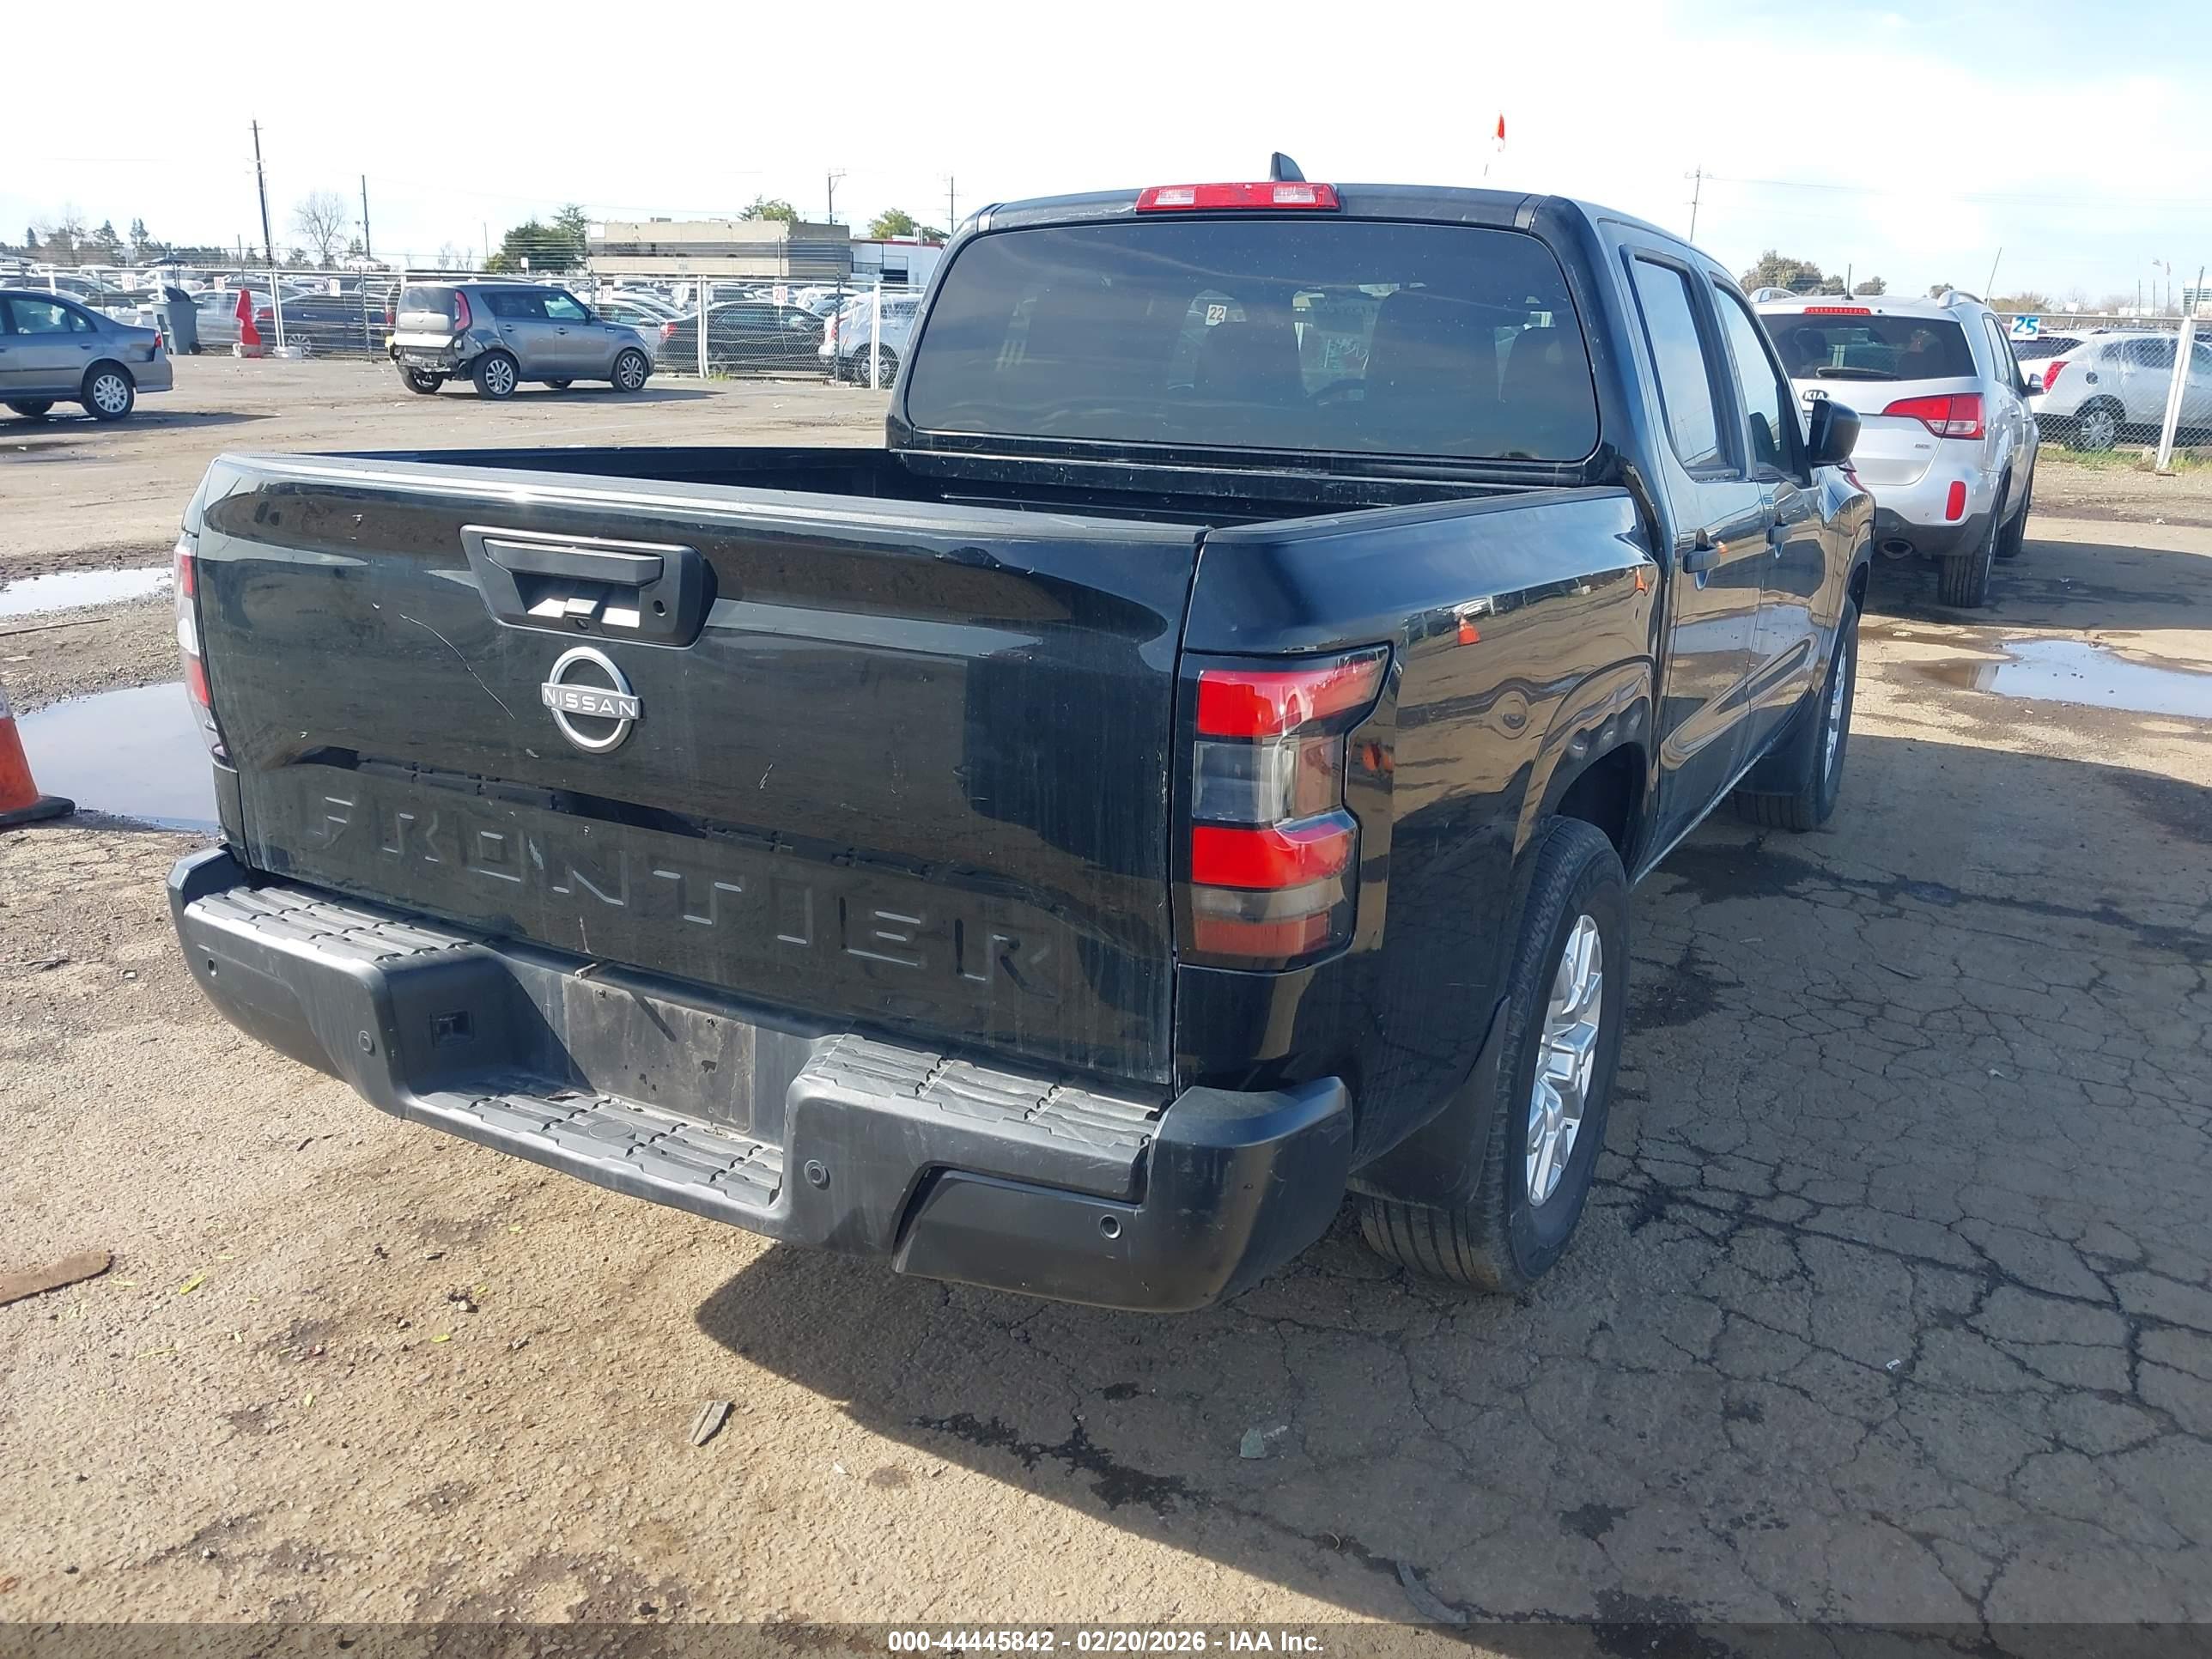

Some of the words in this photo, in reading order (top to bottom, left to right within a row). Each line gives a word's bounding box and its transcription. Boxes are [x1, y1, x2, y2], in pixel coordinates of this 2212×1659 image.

[775, 288, 787, 301] 20
[1208, 306, 1224, 321] 22
[2012, 315, 2039, 336] 25
[1804, 391, 1826, 400] KIA
[544, 688, 635, 717] NISSAN
[302, 784, 1055, 998] FRONTIER
